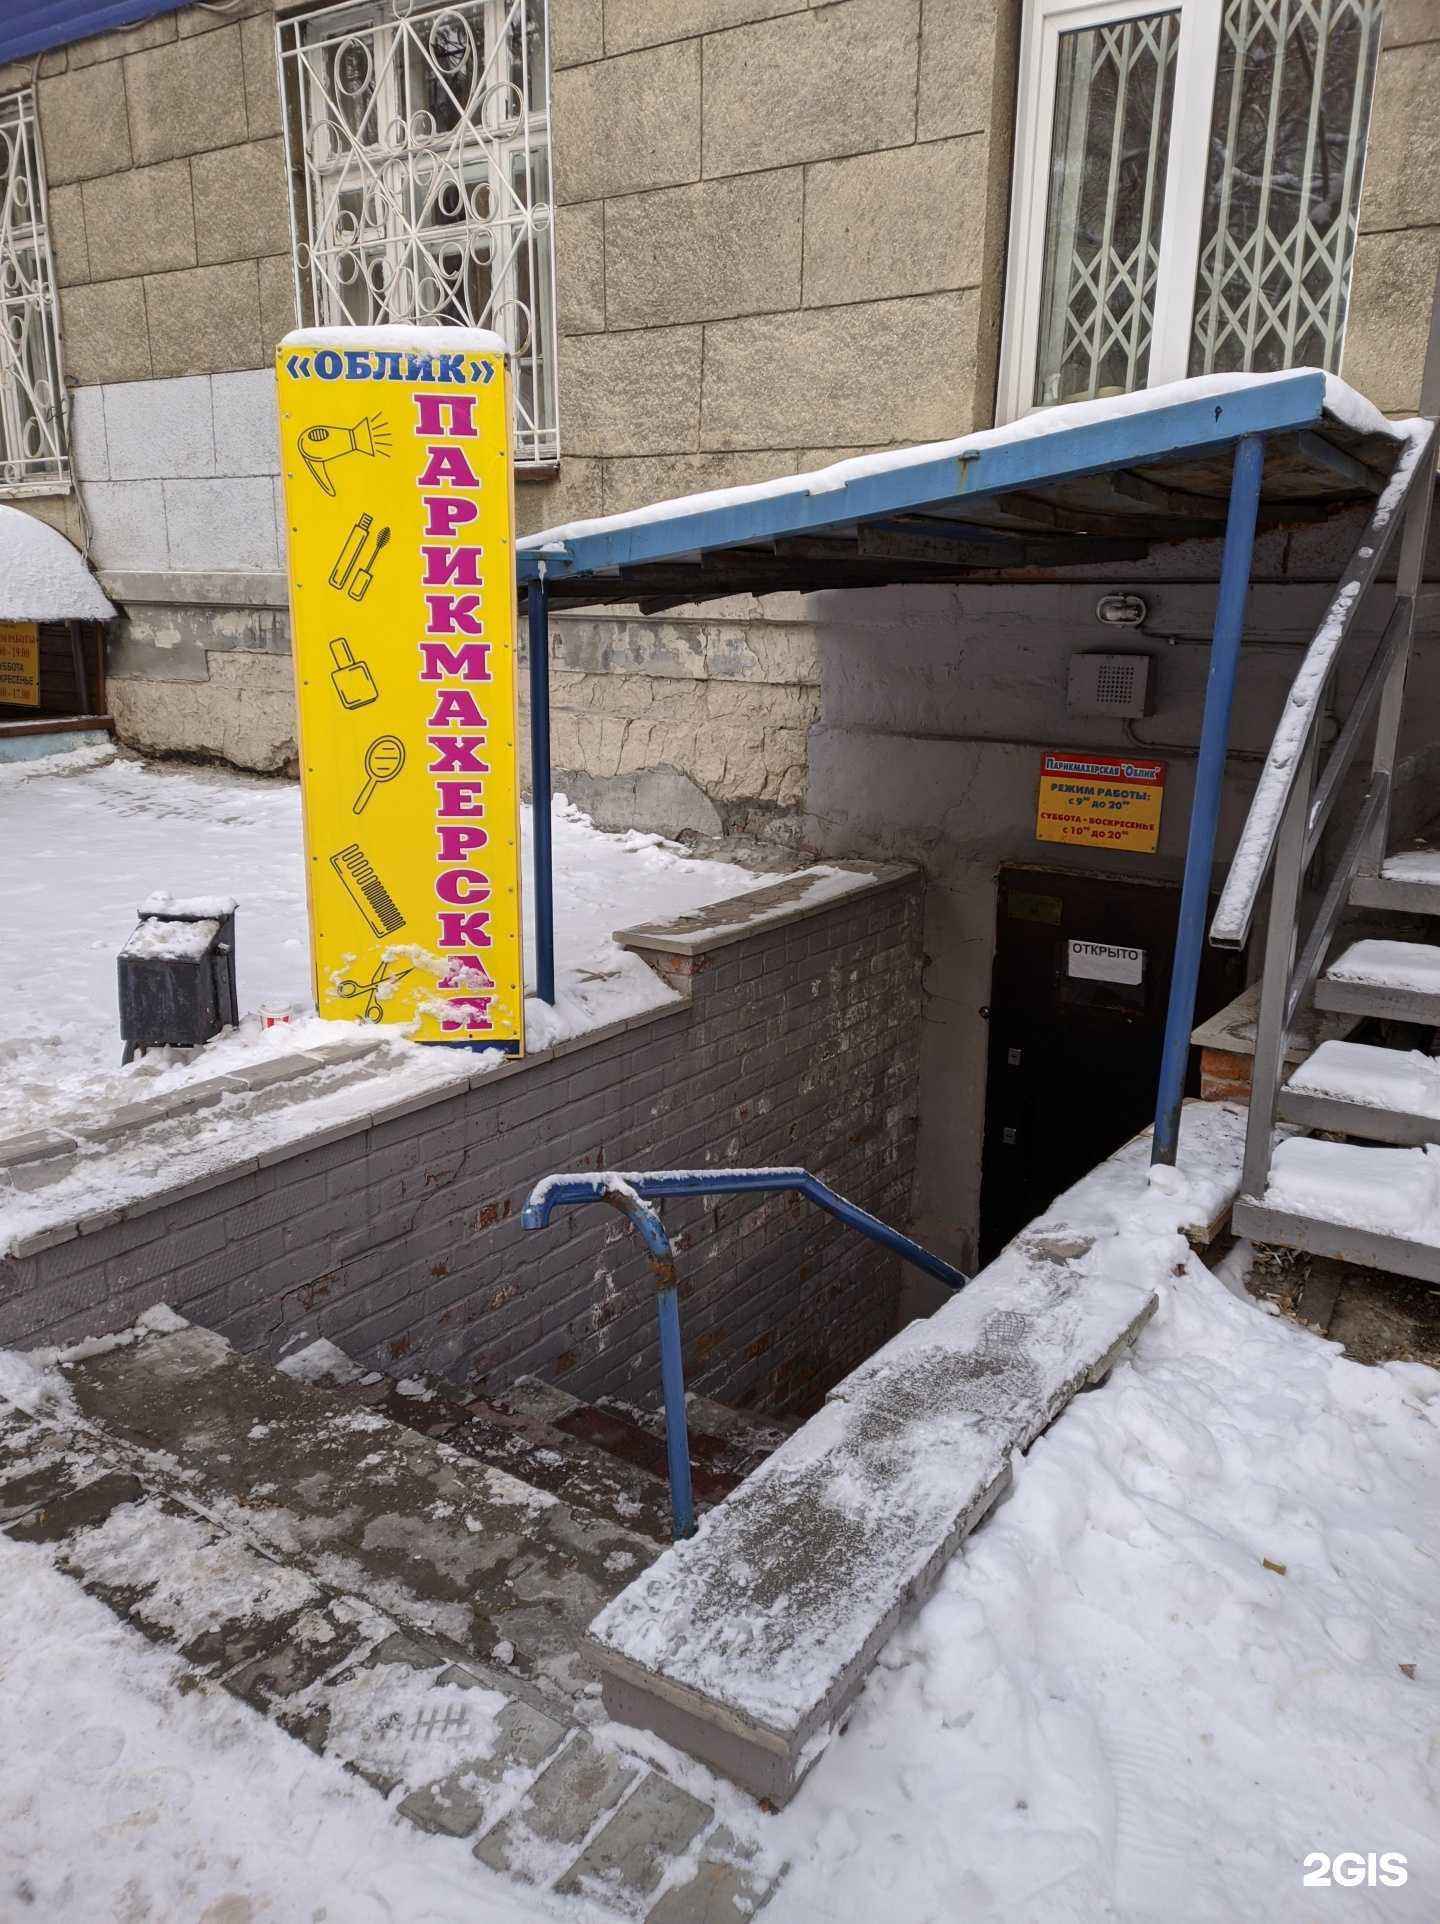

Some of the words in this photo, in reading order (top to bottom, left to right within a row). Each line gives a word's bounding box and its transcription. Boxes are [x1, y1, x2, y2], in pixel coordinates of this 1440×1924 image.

[286, 350, 495, 384] «ОБЛИК»
[413, 394, 494, 1031] ПАРИКМАХЕРСКАЯ
[1050, 783, 1095, 796] РЕЖИМ
[1097, 787, 1151, 801] РАБОТЫ:
[1040, 811, 1082, 824] СУББОТА
[1088, 816, 1155, 832] ВОСКРЕСЕНЬЕ
[1072, 943, 1138, 961] ОТКРЫТО
